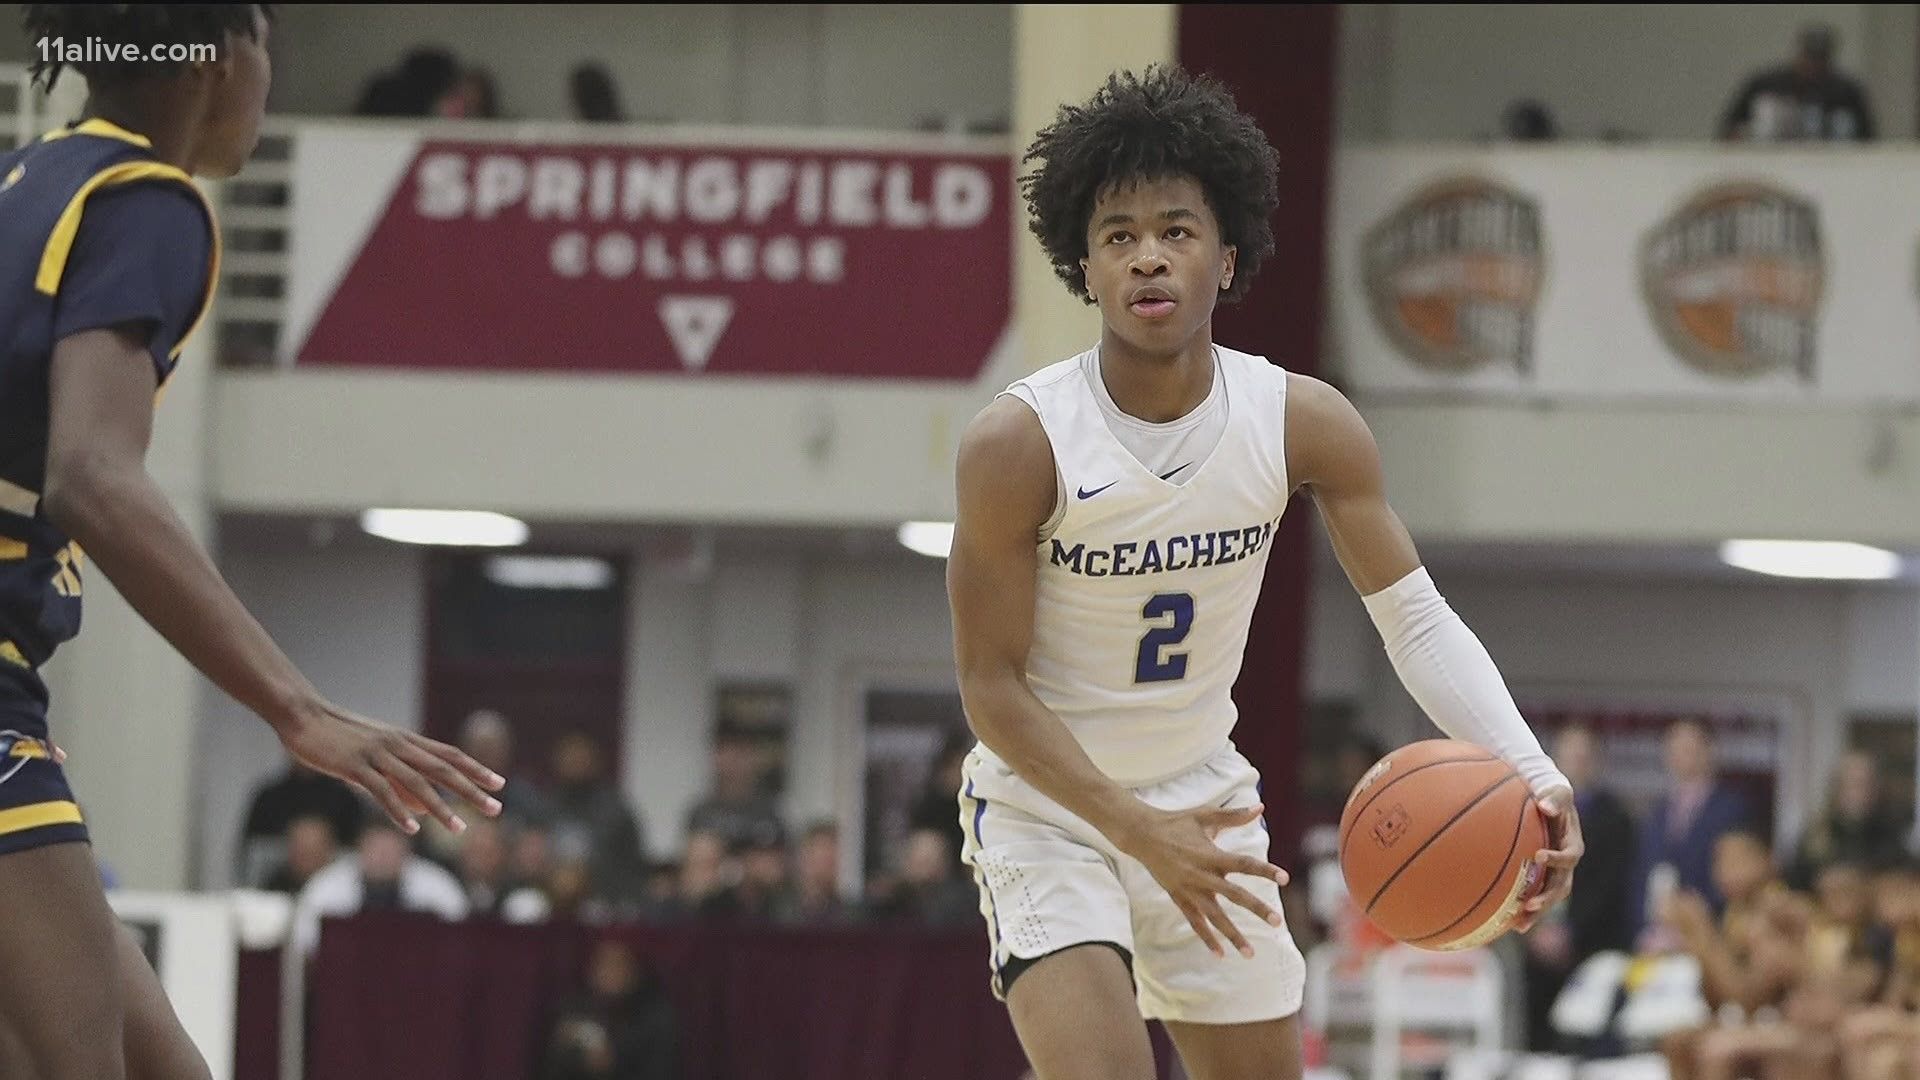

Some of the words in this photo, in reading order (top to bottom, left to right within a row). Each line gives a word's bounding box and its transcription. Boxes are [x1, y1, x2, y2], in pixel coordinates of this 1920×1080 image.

[416, 154, 992, 229] SPRINGFIELD
[549, 232, 845, 283] COLLEGE
[1135, 593, 1194, 683] 2
